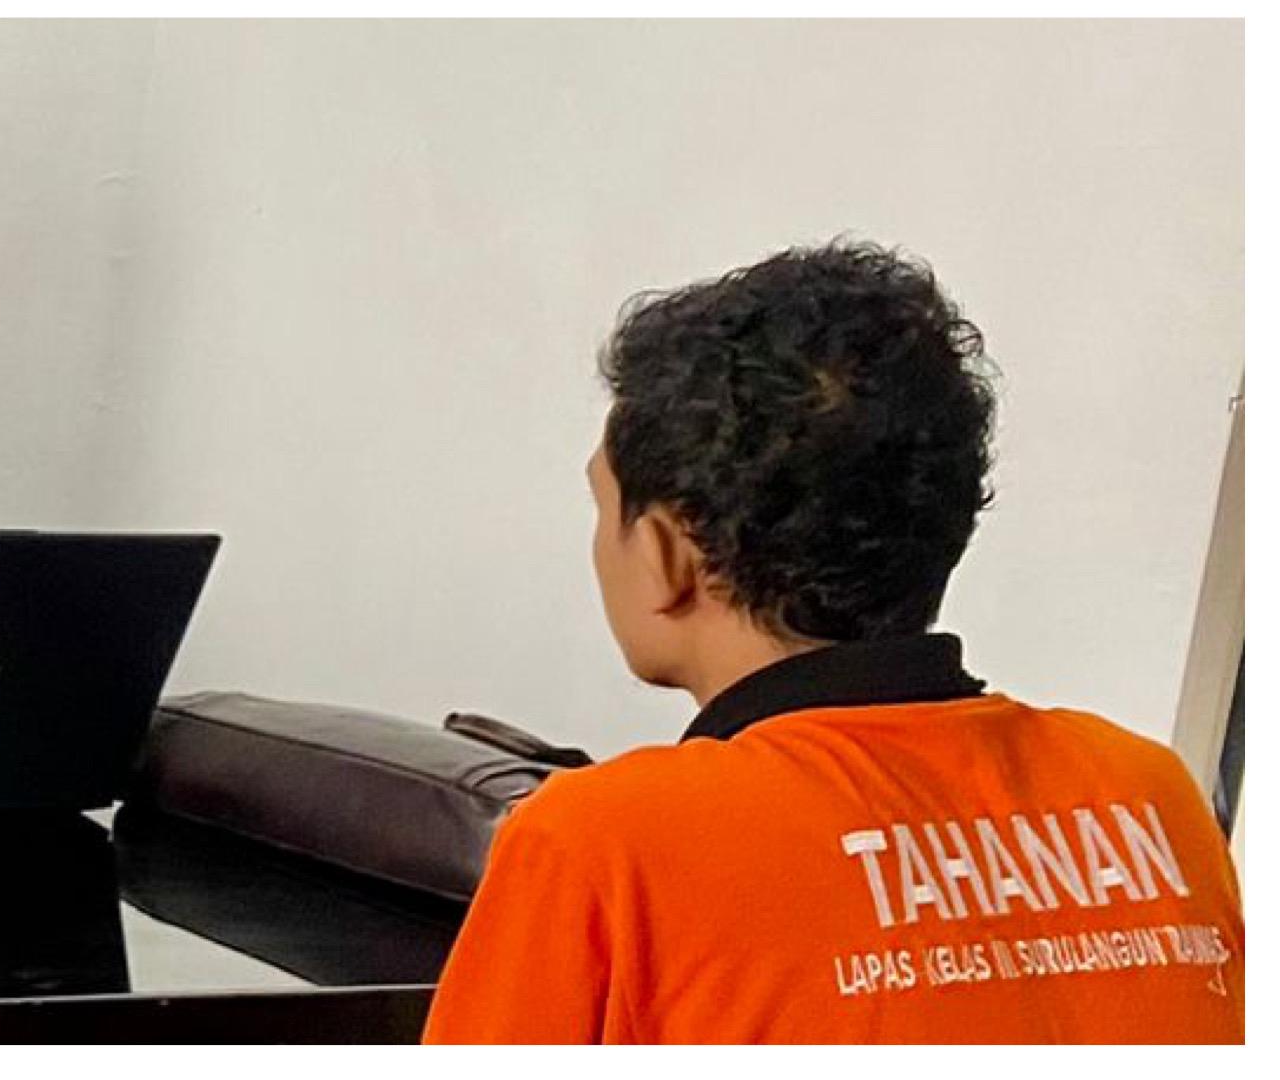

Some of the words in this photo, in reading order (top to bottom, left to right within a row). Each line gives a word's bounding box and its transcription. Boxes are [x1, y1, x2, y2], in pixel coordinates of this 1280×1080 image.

[841, 802, 1190, 928] TAHANAN
[834, 950, 916, 996] LAPAS
[924, 943, 991, 986] KELAS
